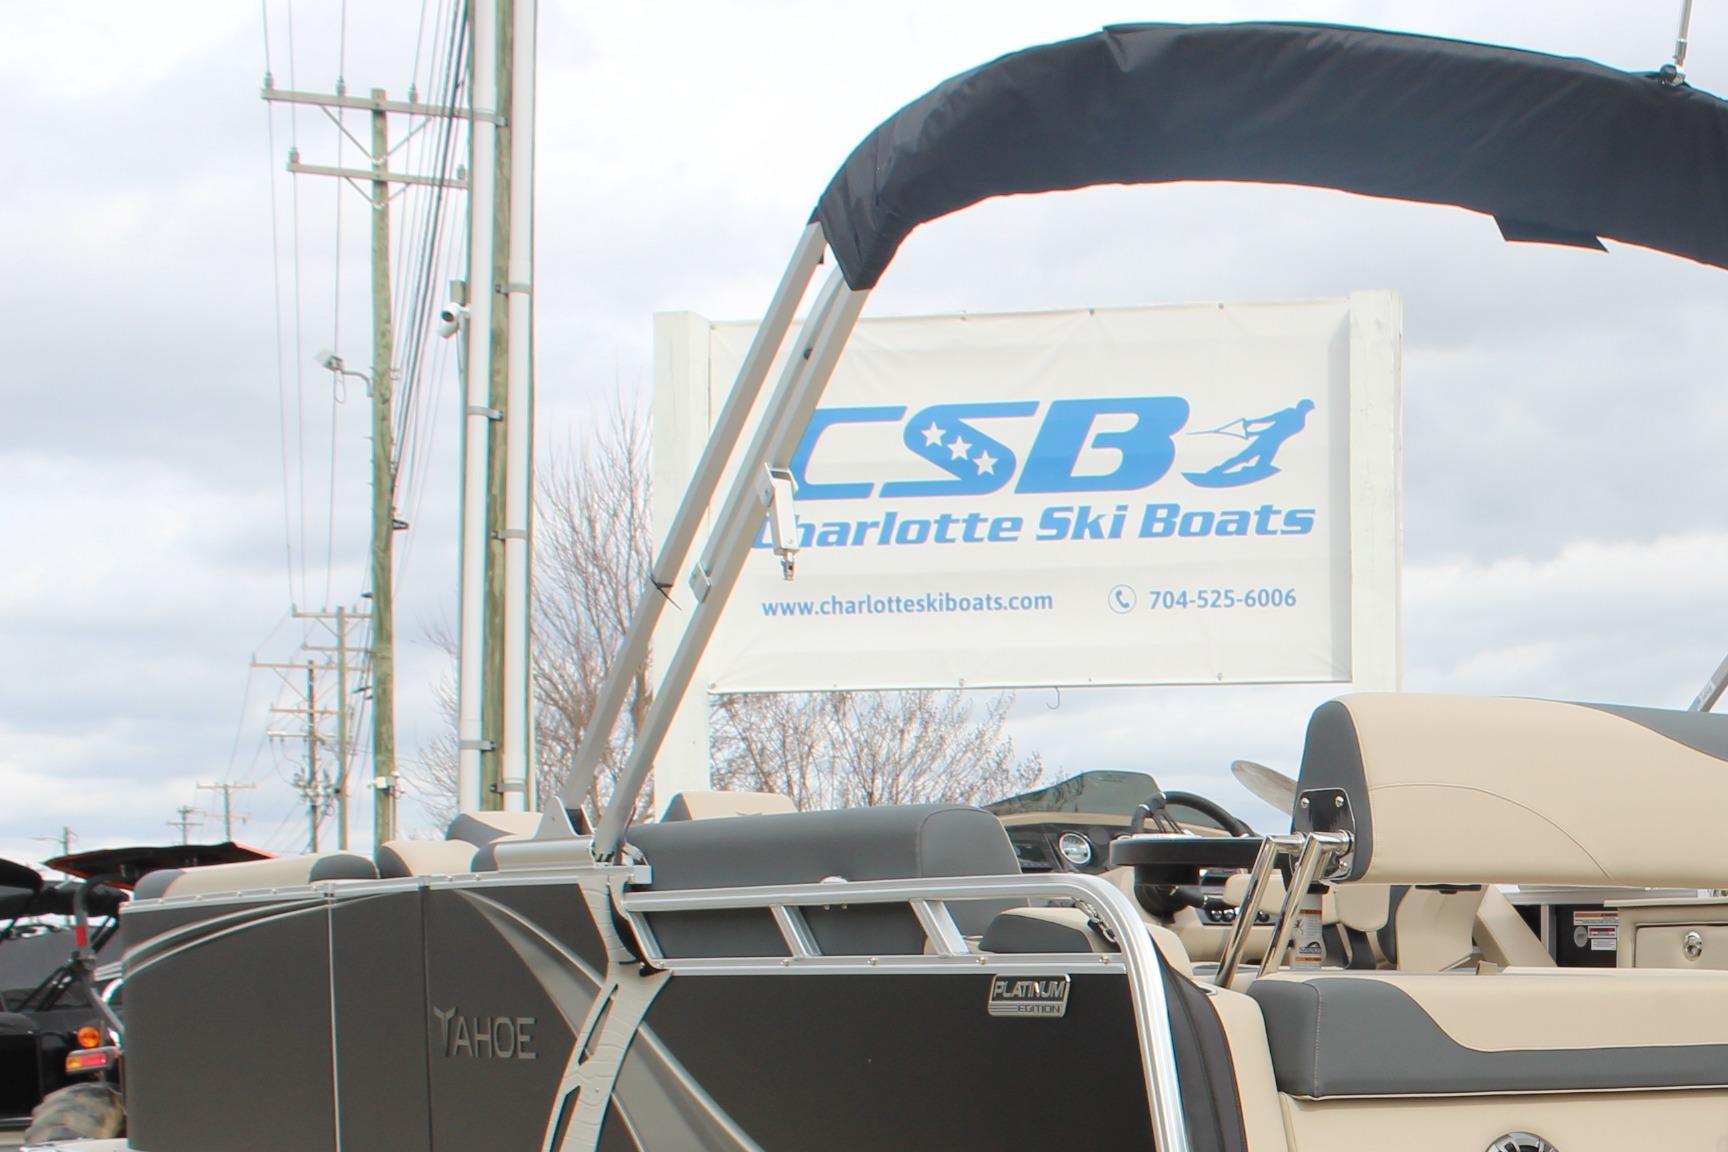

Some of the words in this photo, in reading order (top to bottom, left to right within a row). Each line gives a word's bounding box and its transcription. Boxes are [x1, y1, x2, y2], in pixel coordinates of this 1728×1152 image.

[789, 396, 1189, 501] CSB
[1036, 504, 1128, 541] Ski
[1138, 503, 1316, 538] Boats
[762, 592, 1053, 616] www.charlotteskiboats.com
[1149, 588, 1297, 609] 704-525-6006
[993, 980, 1066, 998] PLATINUM
[1017, 1004, 1060, 1013] EDITION
[433, 1006, 538, 1059] TAHOE
